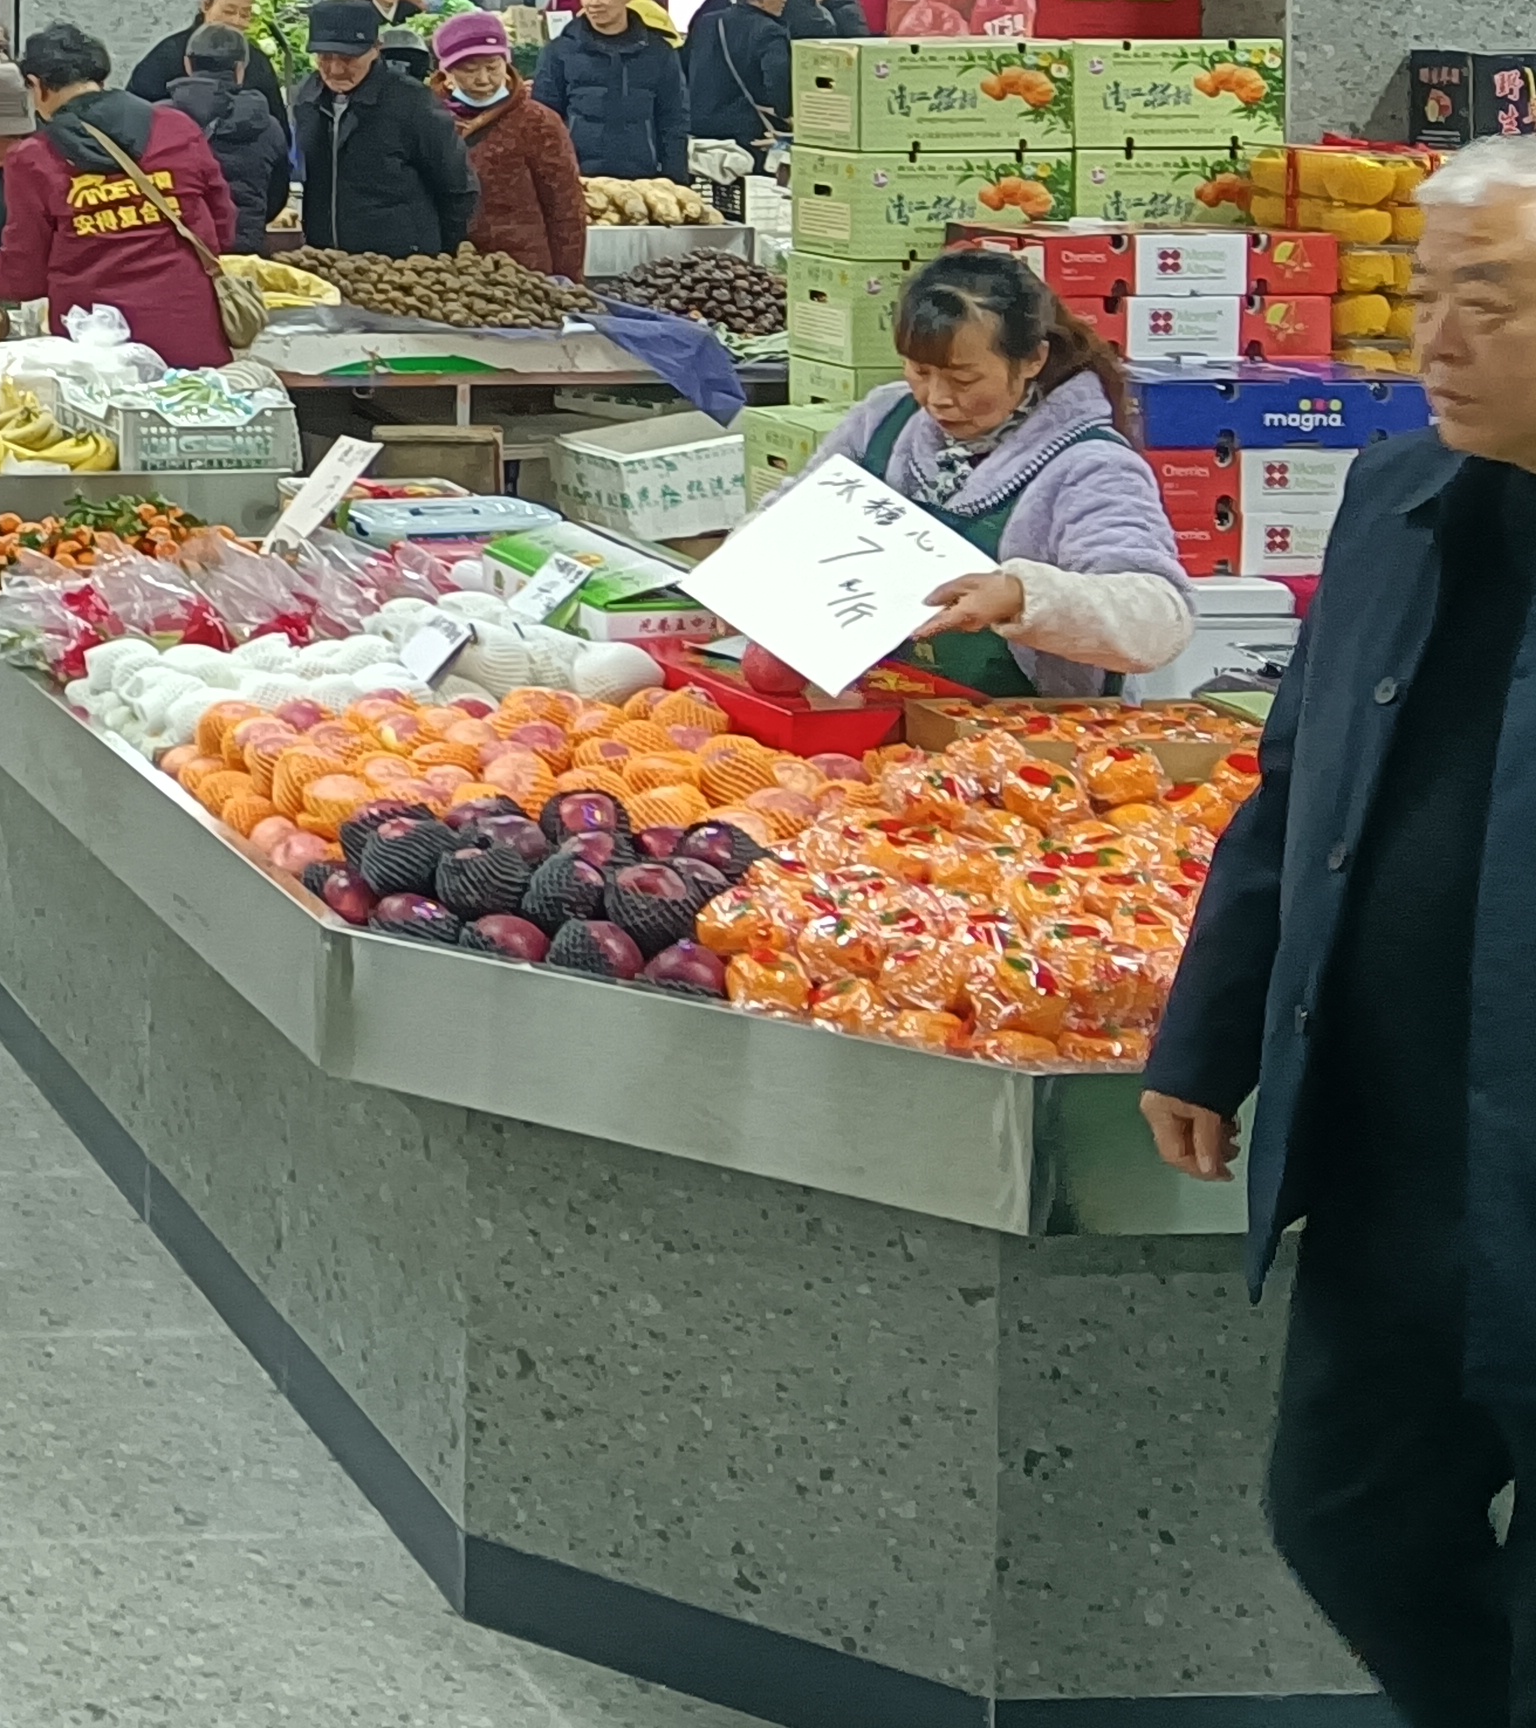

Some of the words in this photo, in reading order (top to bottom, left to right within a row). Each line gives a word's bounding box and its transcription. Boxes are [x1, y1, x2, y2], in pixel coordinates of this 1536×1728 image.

[1263, 412, 1345, 432] magna
[817, 472, 946, 559] 冰糖心
[818, 535, 886, 564] 7
